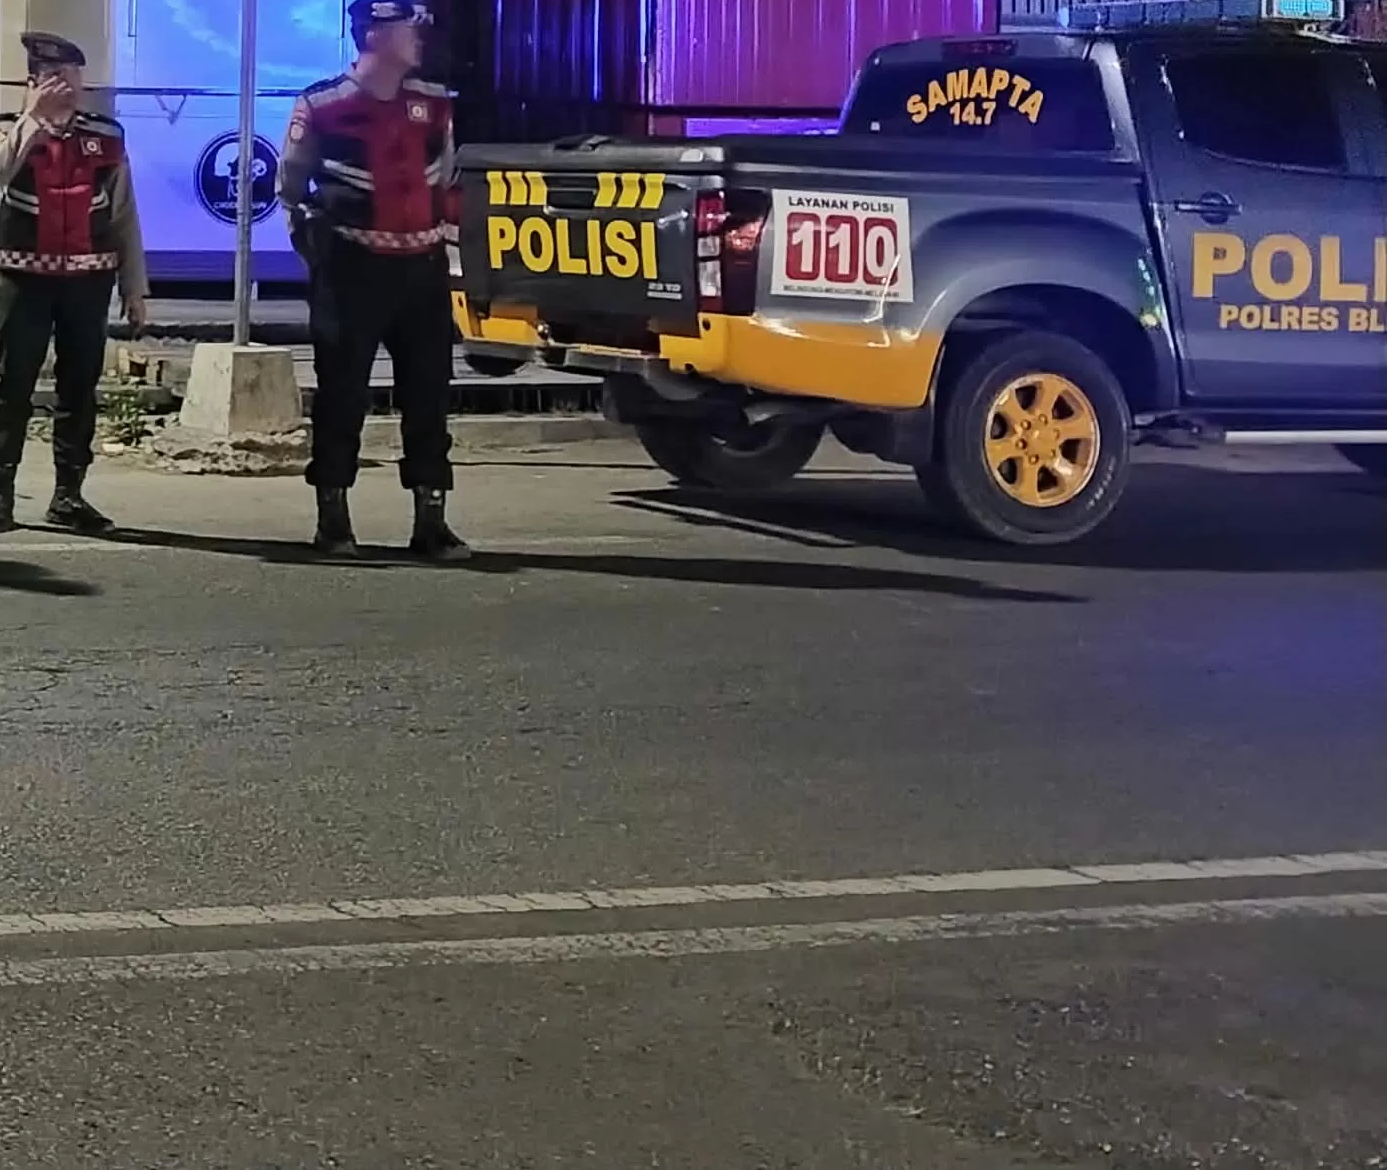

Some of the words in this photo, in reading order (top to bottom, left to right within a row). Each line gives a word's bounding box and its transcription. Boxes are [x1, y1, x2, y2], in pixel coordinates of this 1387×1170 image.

[906, 67, 1044, 124] SAMAPTA
[949, 101, 997, 126] 14.7
[788, 196, 849, 210] LAYANAN
[853, 201, 894, 213] POLISI
[487, 216, 658, 279] POLISI
[791, 220, 896, 278] 110
[1219, 304, 1340, 331] POLRES
